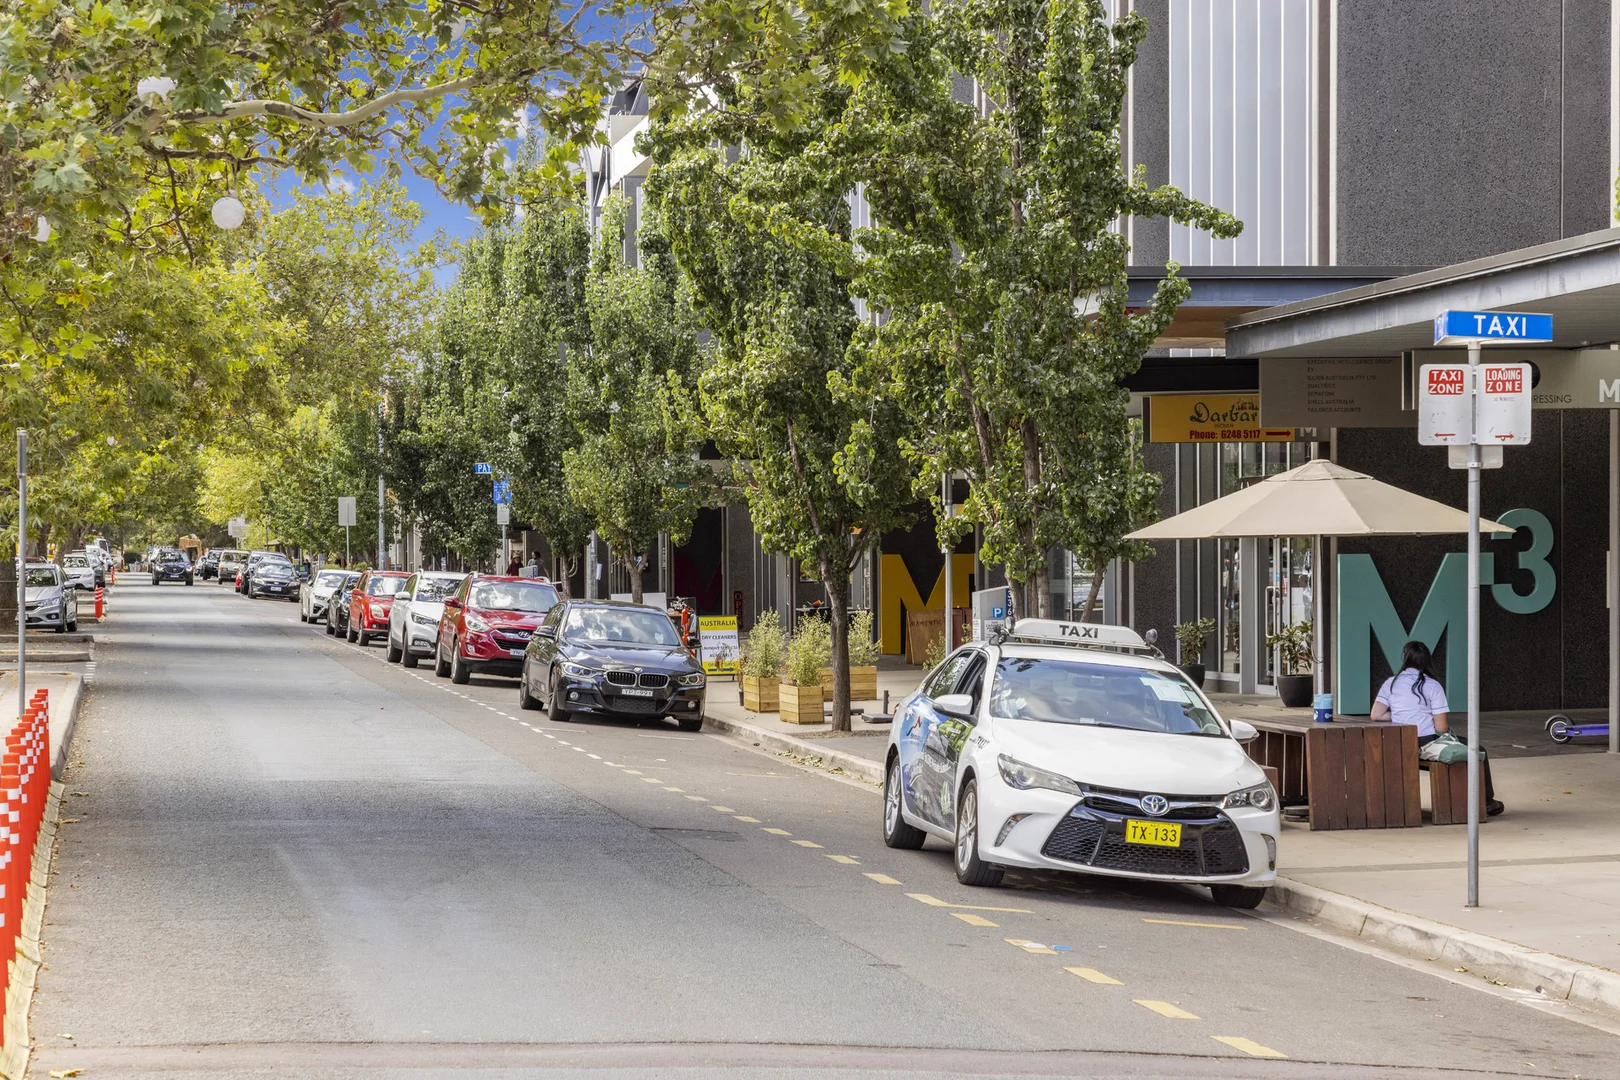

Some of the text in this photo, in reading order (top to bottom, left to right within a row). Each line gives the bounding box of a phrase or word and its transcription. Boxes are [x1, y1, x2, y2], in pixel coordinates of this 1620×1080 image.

[1473, 314, 1527, 337] TAXI
[1431, 370, 1461, 381] TAXI
[1486, 369, 1521, 381] LOADING
[1428, 383, 1463, 394] ZONE
[1486, 381, 1521, 392] ZONE
[1189, 401, 1258, 424] Darbar
[1189, 429, 1261, 440] Phone: 6248 5117
[994, 608, 1002, 618] P
[700, 619, 736, 627] AUSTRALIA
[1059, 624, 1099, 639] TAXI
